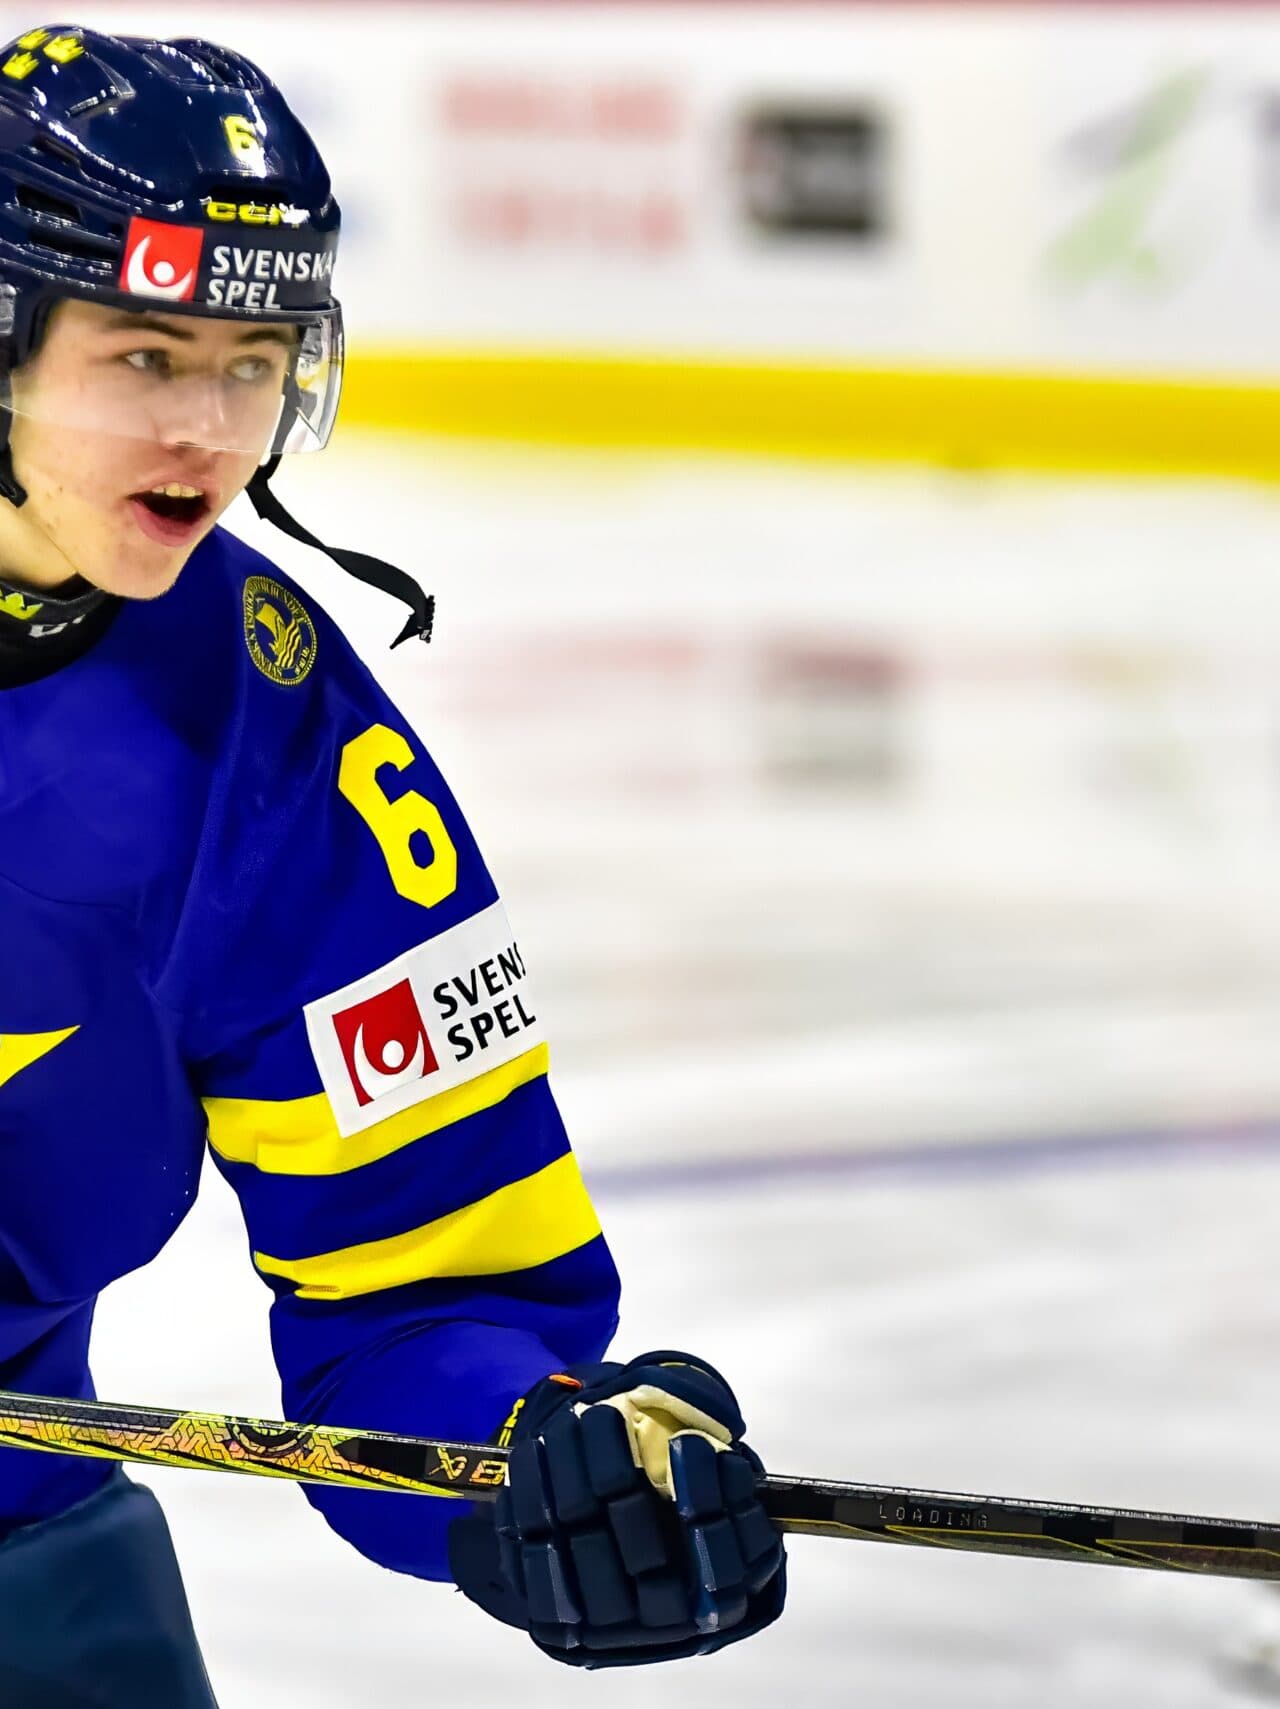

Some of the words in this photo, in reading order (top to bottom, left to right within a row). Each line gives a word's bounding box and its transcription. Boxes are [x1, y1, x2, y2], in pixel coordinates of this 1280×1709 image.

[223, 115, 266, 177] 6
[205, 279, 281, 310] SPEL
[210, 245, 334, 282] SVENSKA
[338, 723, 458, 909] 6
[432, 941, 526, 1021] SVEN
[446, 993, 537, 1063] SPEL
[879, 1503, 988, 1529] LOADING
